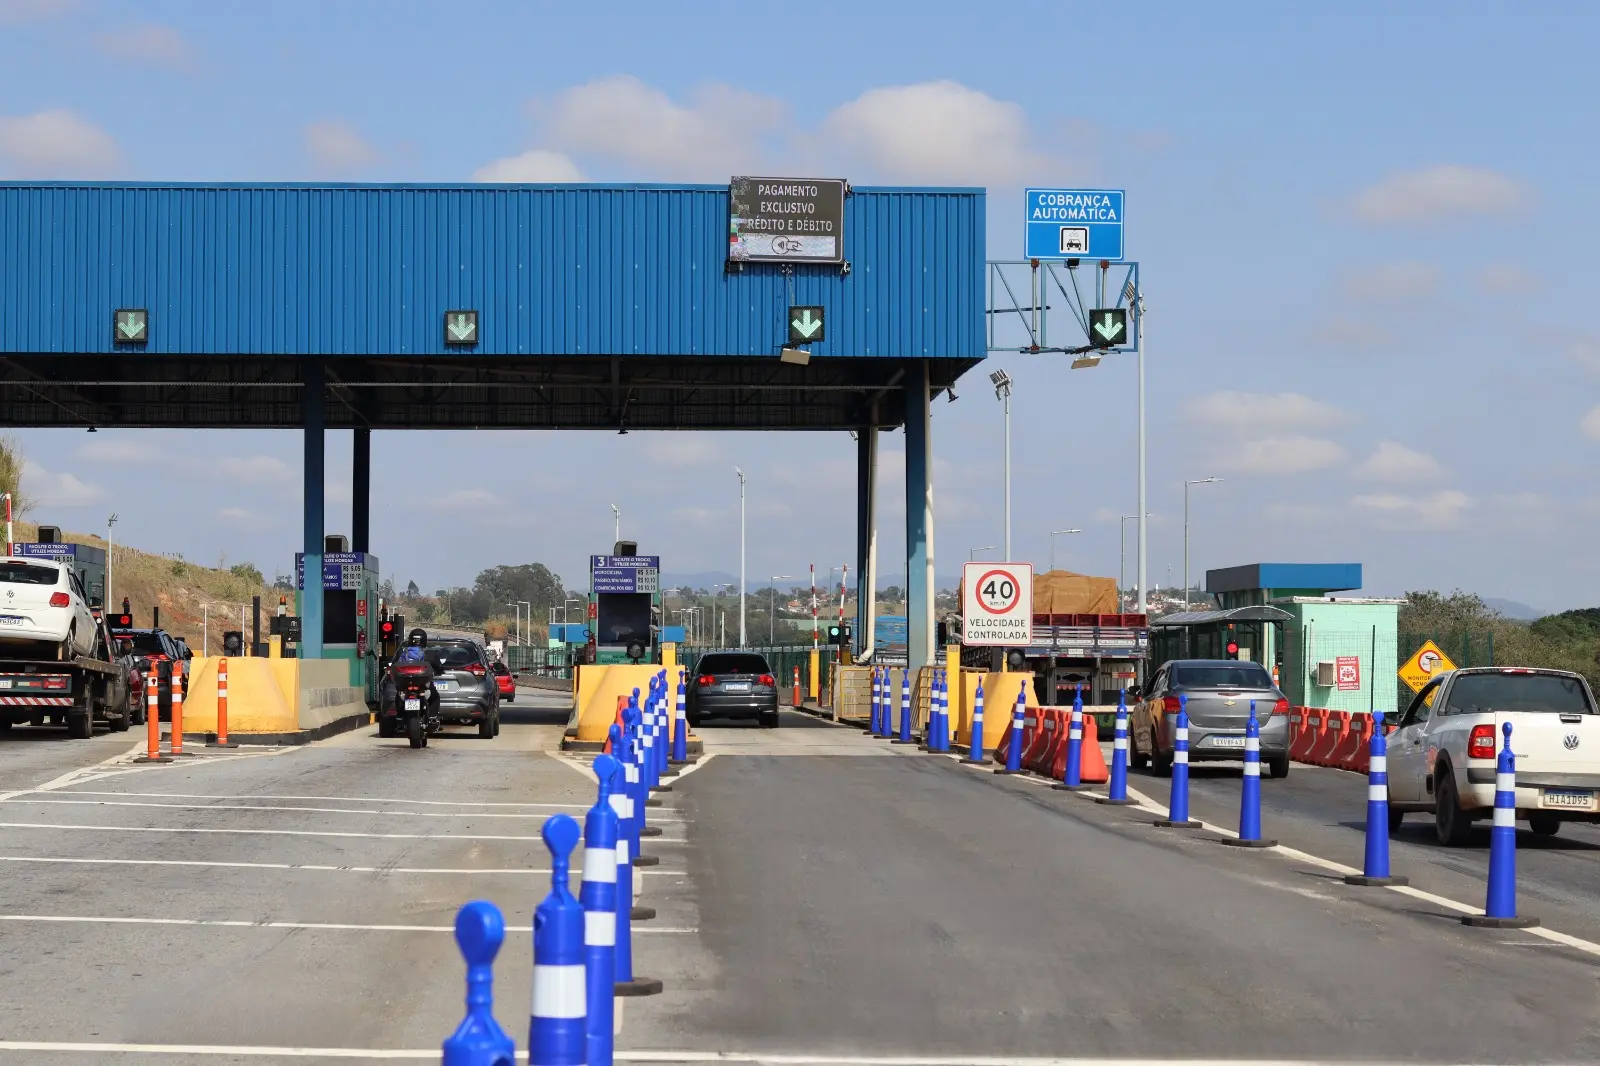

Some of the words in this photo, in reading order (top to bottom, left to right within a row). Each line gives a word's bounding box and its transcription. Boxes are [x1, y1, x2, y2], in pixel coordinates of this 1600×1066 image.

[758, 184, 818, 197] PAGAMENTO
[760, 201, 815, 214] EXCLUSIVO
[1038, 194, 1111, 208] COBRANÇA
[1032, 204, 1117, 220] AUTOMÁTICA
[745, 214, 785, 231] RÉDITO
[787, 219, 793, 231] E
[796, 216, 833, 232] DÉBITO
[13, 543, 22, 554] 5
[597, 556, 605, 567] 3
[982, 580, 1013, 599] 40
[969, 618, 1026, 627] VELOCIDADE
[967, 631, 1028, 640] CONTROLADA
[1549, 794, 1589, 805] HIA1D95
